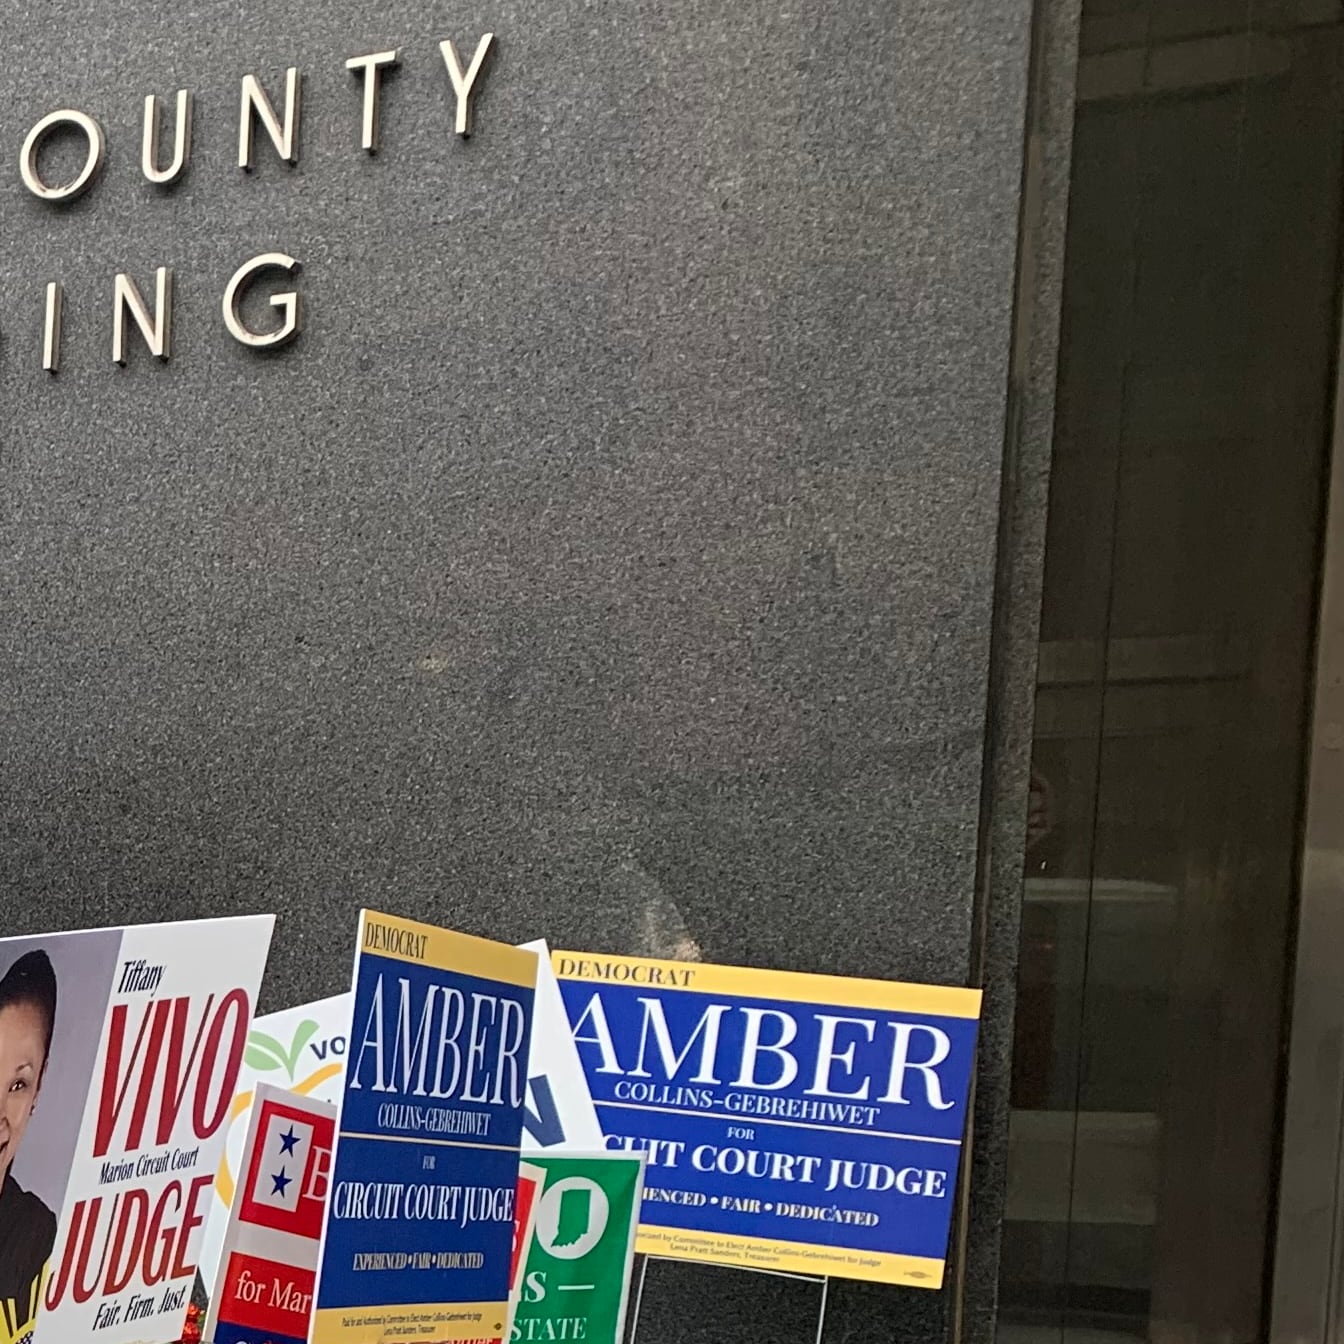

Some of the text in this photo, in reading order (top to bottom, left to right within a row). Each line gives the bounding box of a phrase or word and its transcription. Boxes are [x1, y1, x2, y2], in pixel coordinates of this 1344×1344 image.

[365, 921, 429, 959] DEMOCRAT
[117, 959, 167, 996] Tiffany
[558, 957, 696, 987] DEMOCRAT
[349, 972, 526, 1109] AMBER
[572, 991, 955, 1111] AMBER
[92, 987, 250, 1158] VIVO
[377, 1102, 492, 1137] COLLINS-GEBREHIWET
[613, 1080, 881, 1127] COLLINS-GEBREHIWET
[727, 1125, 755, 1142] FOR
[99, 1146, 200, 1186] Marion Circuit Court
[422, 1155, 436, 1170] FOR
[691, 1143, 821, 1184] COURT
[824, 1158, 948, 1199] JUDGE
[333, 1181, 514, 1229] CIRCUIT COURT JUDGE
[720, 1198, 761, 1214] FAIR
[775, 1203, 881, 1227] DEDICATED
[44, 1174, 215, 1312] JUDGE
[236, 1270, 313, 1312] for Mar
[509, 1317, 587, 1341] STATE
